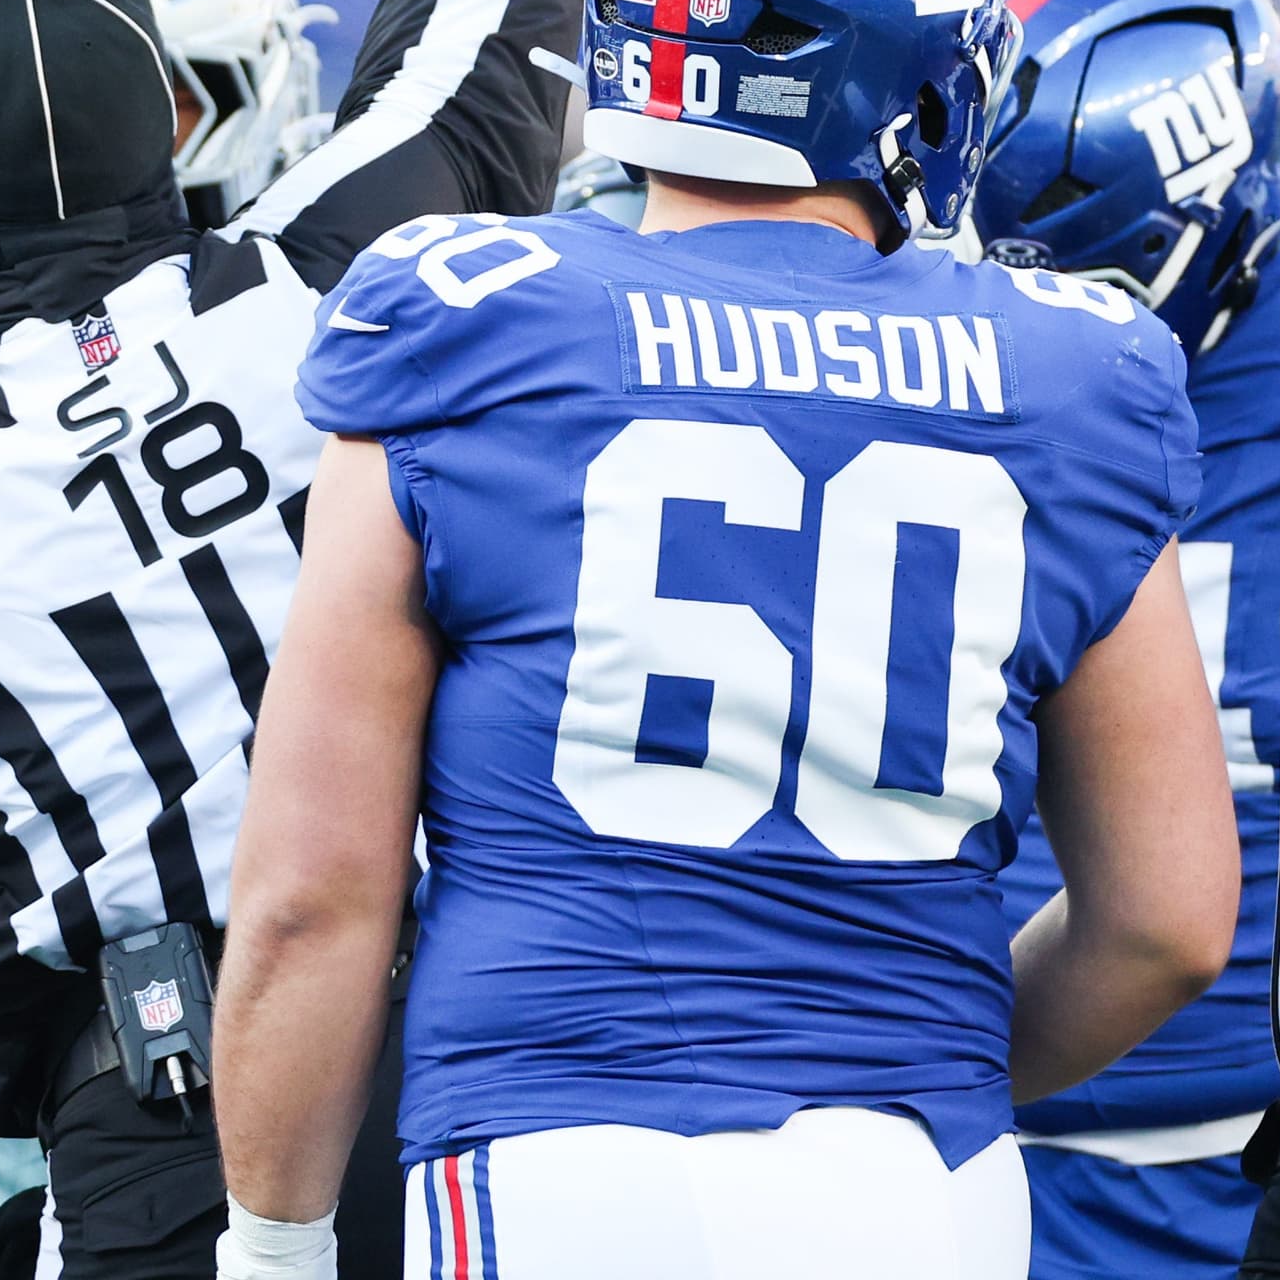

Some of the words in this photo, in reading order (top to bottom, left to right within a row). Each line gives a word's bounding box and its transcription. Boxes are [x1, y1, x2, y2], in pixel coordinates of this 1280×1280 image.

[622, 39, 721, 117] 60
[56, 341, 190, 459] SJ
[80, 335, 121, 363] NFL
[624, 291, 1006, 414] HUDSON
[62, 401, 270, 567] 18
[552, 418, 1028, 862] 60
[144, 1001, 178, 1024] NFL
